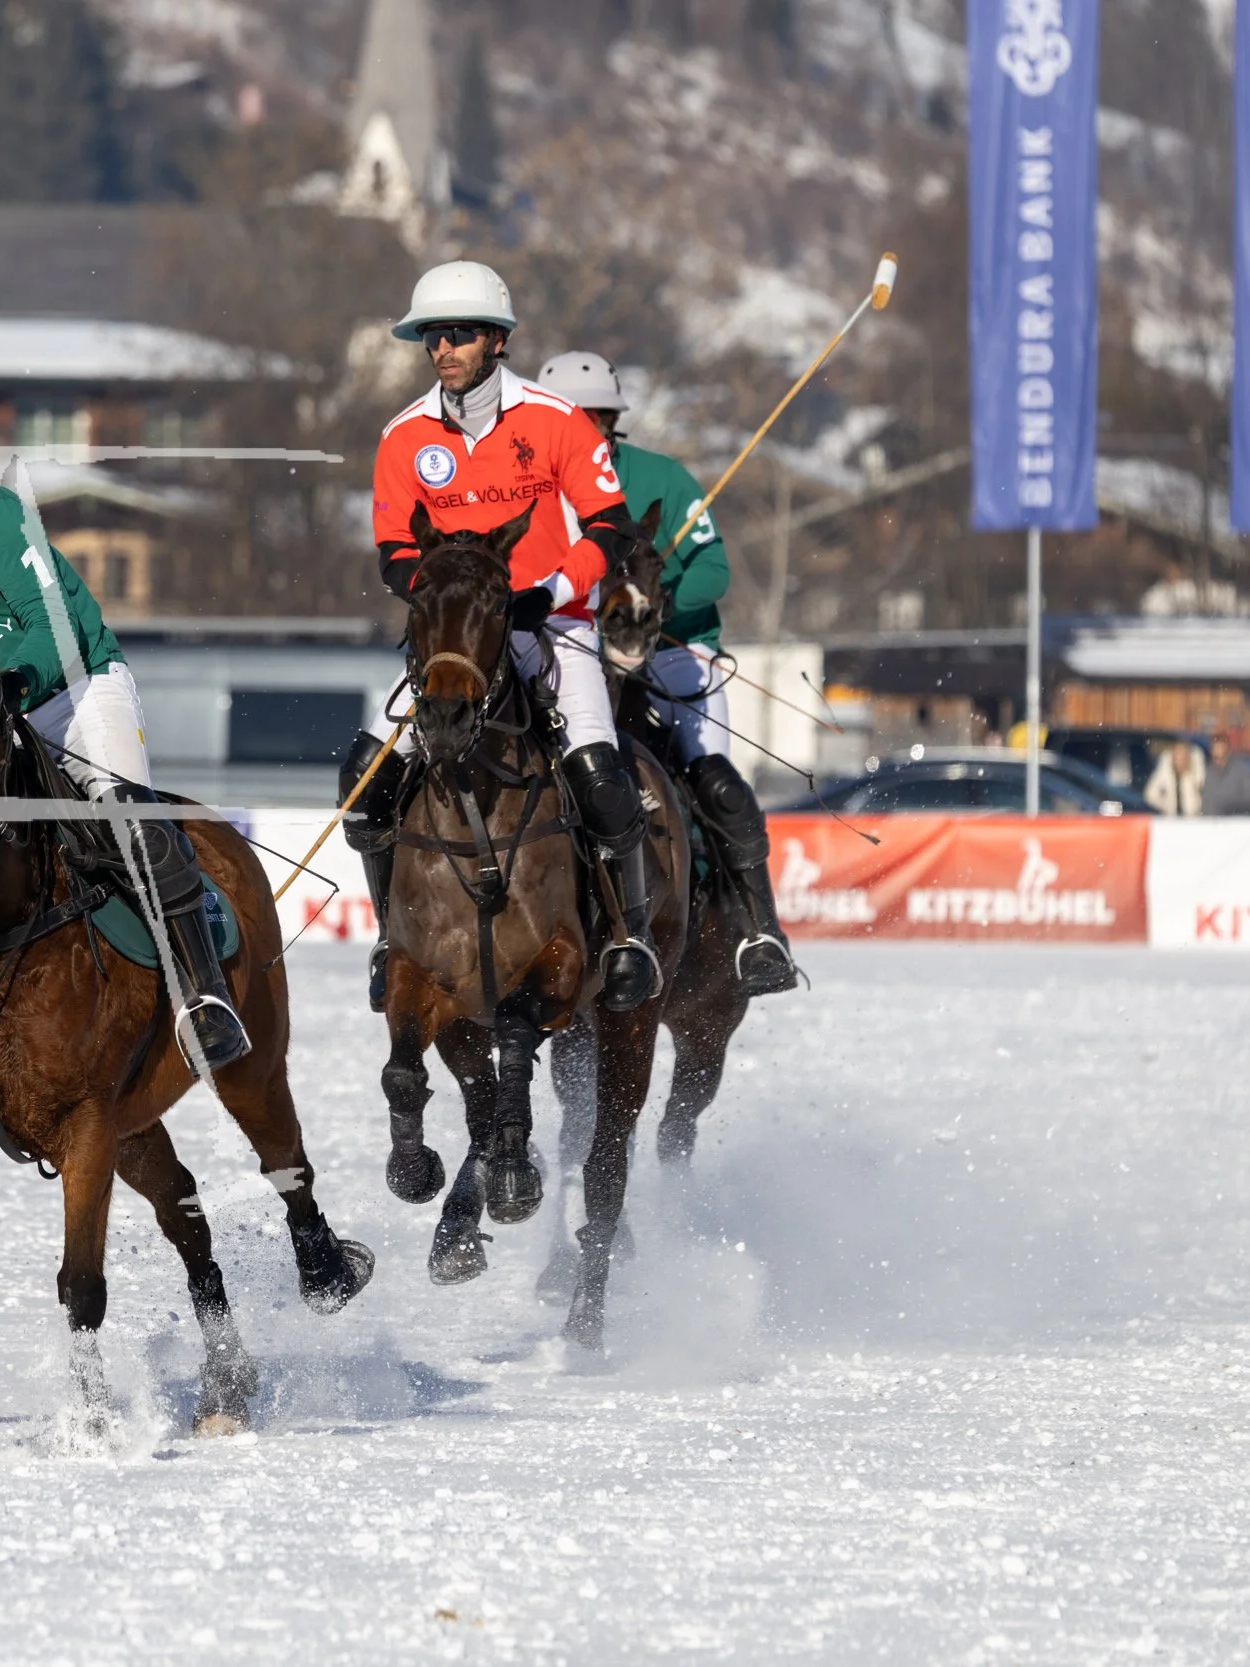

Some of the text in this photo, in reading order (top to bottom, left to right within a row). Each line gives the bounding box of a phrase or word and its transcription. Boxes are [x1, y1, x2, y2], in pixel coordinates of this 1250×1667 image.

[1017, 126, 1055, 508] BENDURA BANK
[591, 441, 620, 493] 3
[20, 544, 55, 588] 1
[1194, 903, 1250, 941] KI
